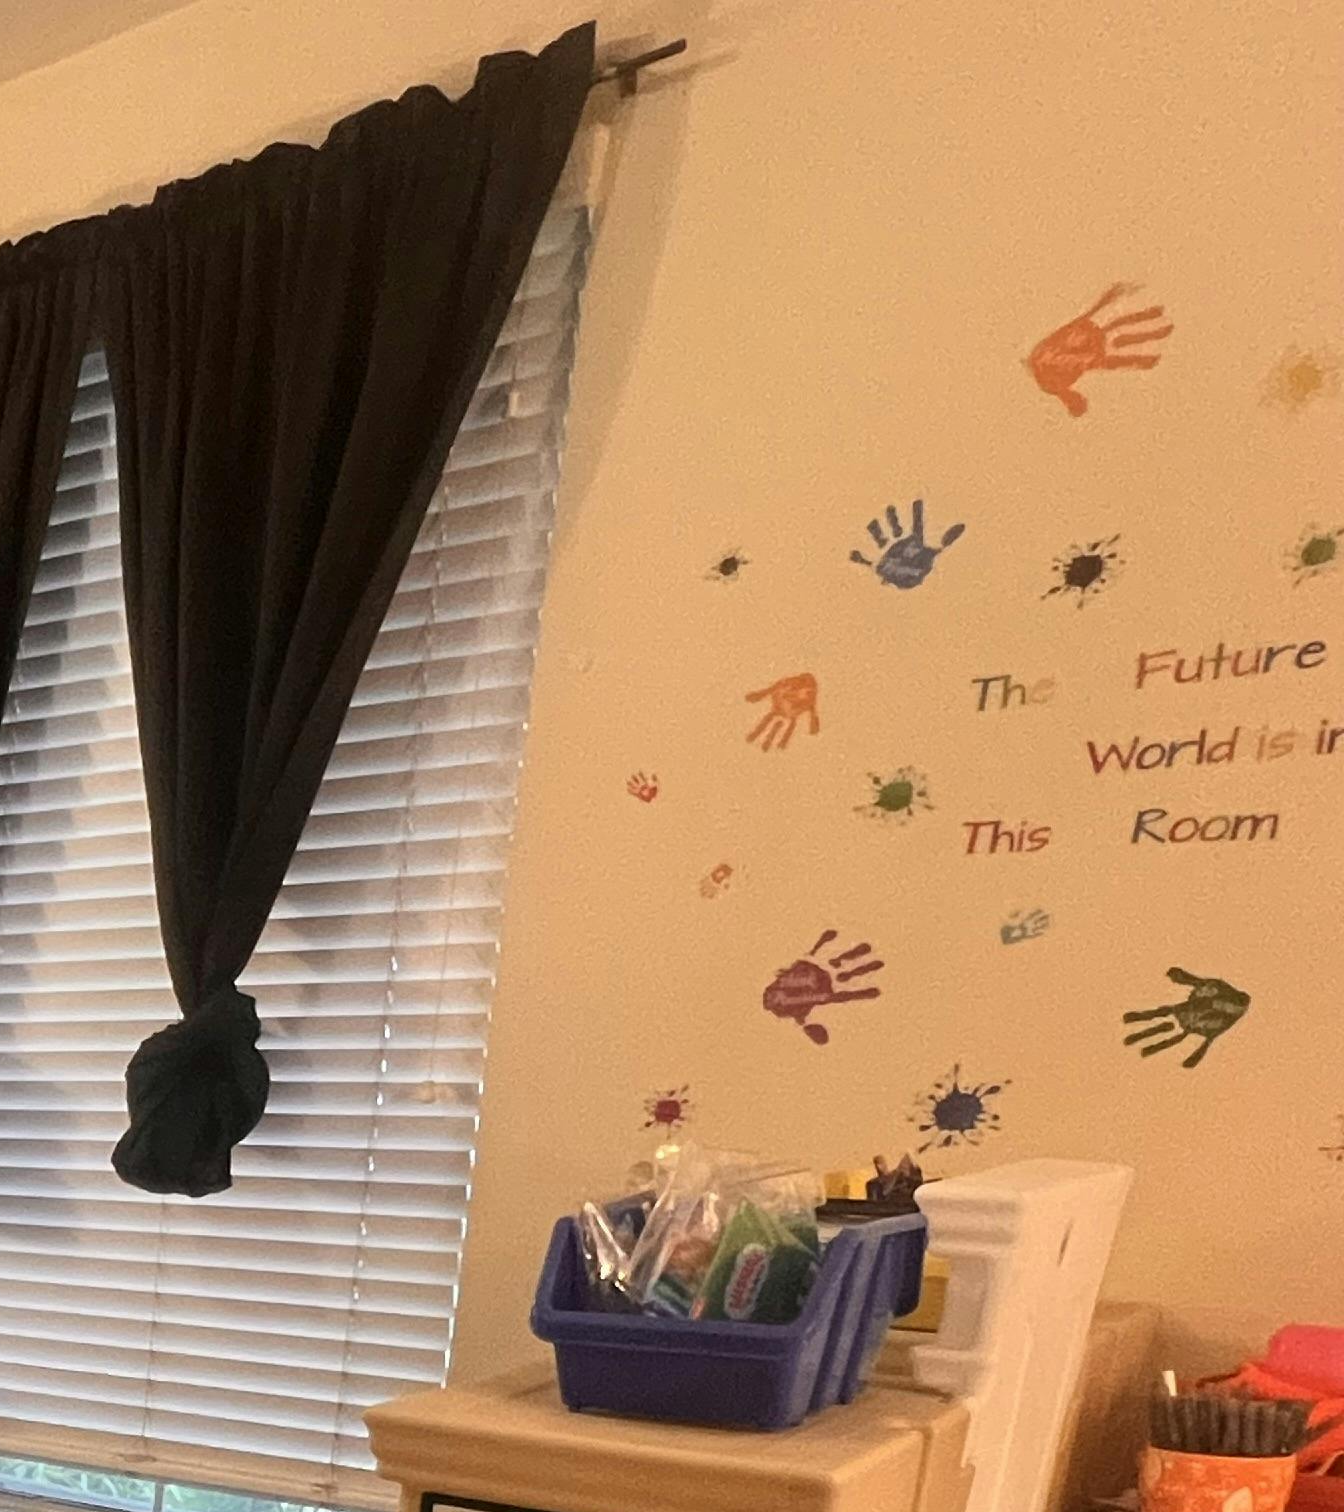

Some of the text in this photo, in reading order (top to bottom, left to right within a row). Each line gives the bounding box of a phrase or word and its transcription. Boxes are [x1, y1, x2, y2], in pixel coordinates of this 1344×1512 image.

[972, 639, 1327, 713] The Future
[1086, 726, 1240, 775] World
[1255, 724, 1298, 764] is
[963, 807, 1280, 855] This Room
